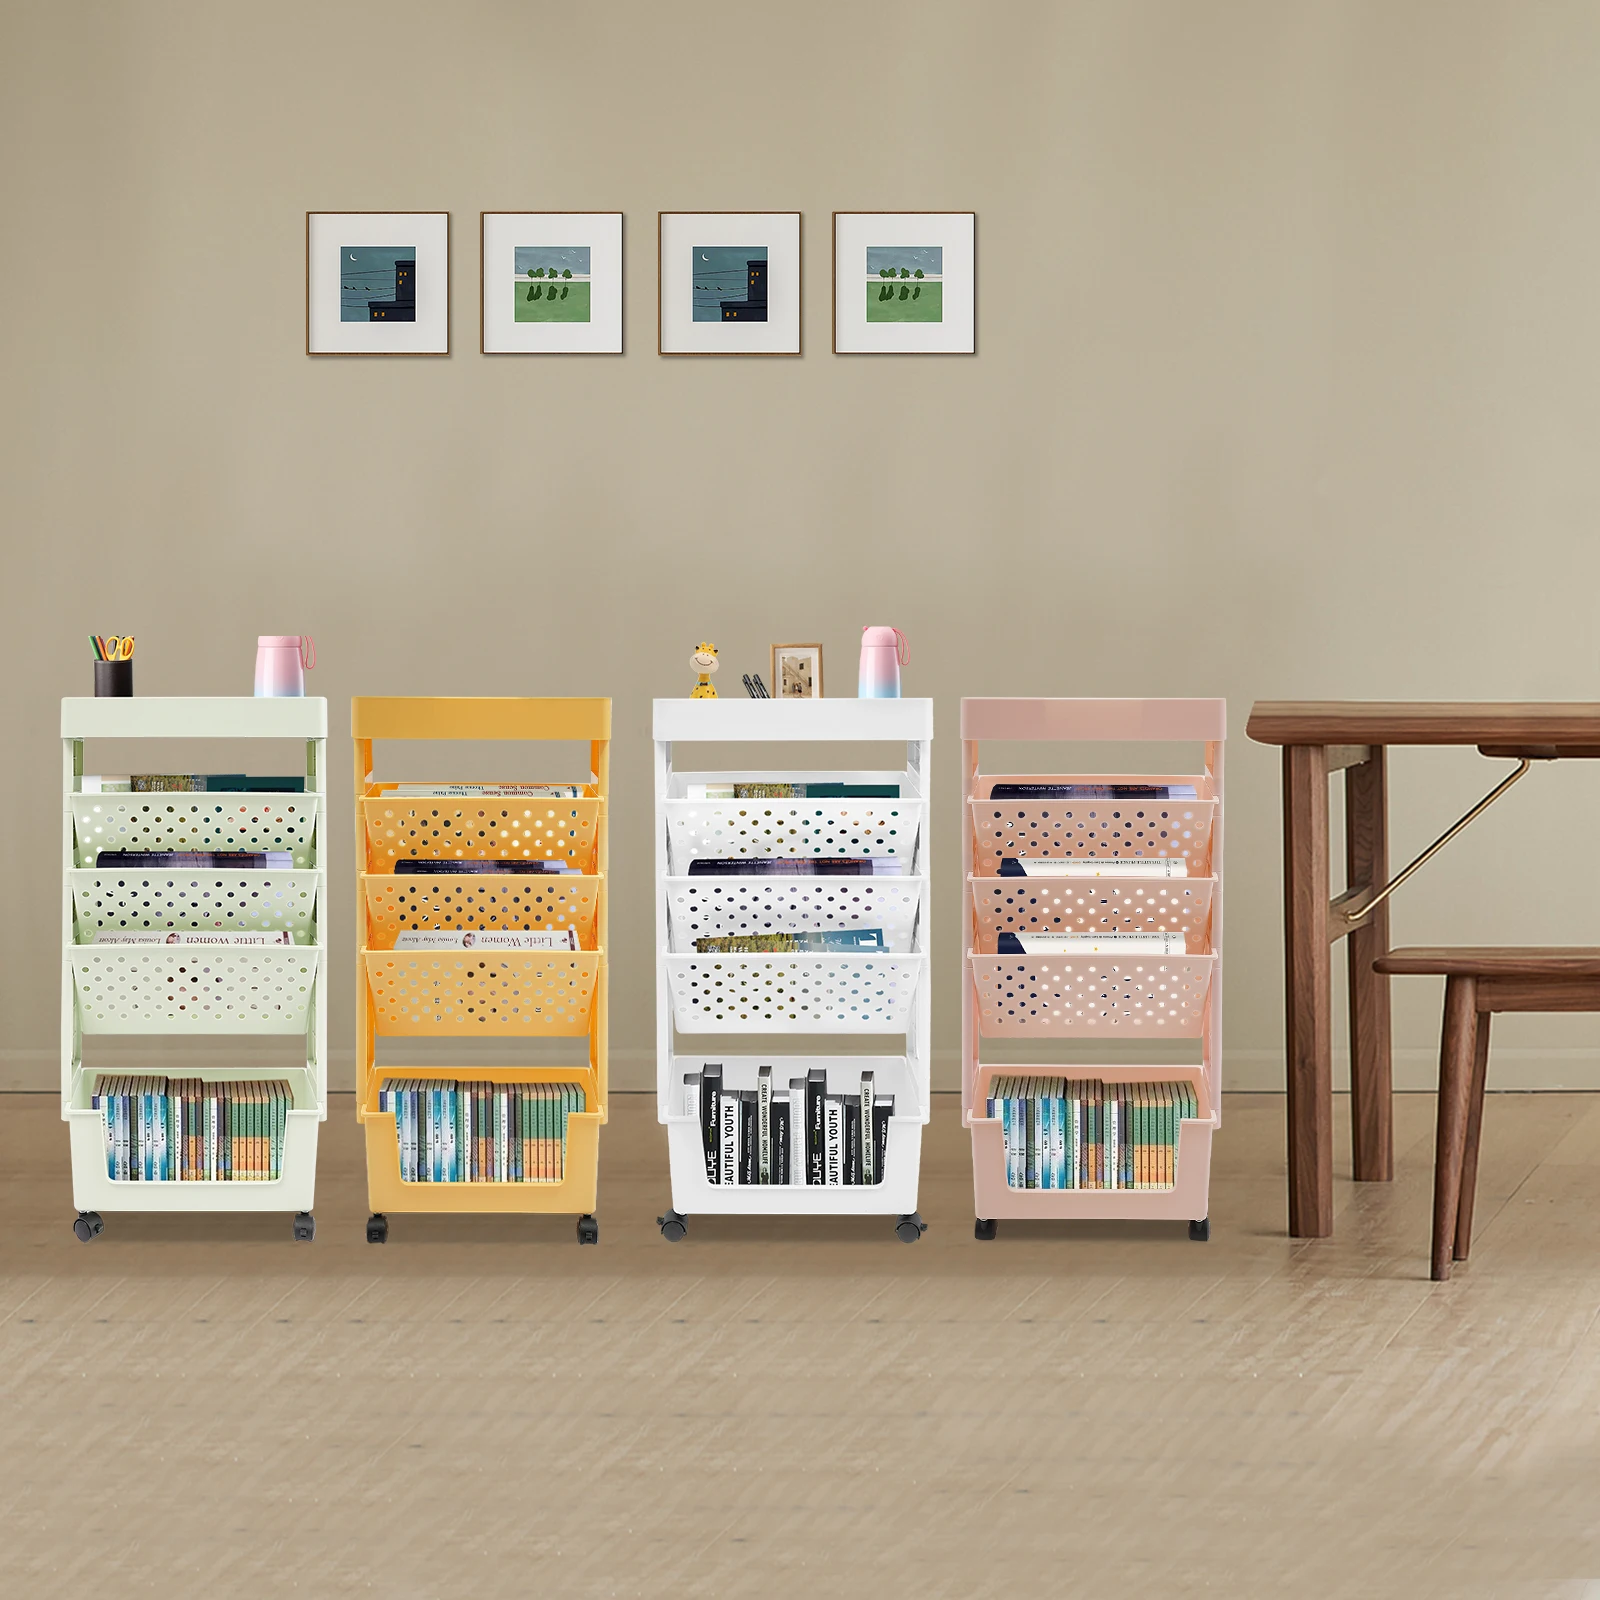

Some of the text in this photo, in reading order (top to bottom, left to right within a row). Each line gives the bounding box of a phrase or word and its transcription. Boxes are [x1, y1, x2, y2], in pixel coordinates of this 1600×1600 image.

[121, 936, 137, 945] May
[137, 936, 161, 945] Louisa
[186, 936, 230, 945] Women
[233, 936, 265, 945] Little
[481, 936, 521, 947] Women
[524, 936, 553, 947] Little
[709, 1090, 717, 1127] Furniture
[724, 1105, 734, 1139] YOUTH
[828, 1109, 839, 1185] AUTIFUL YOUTH
